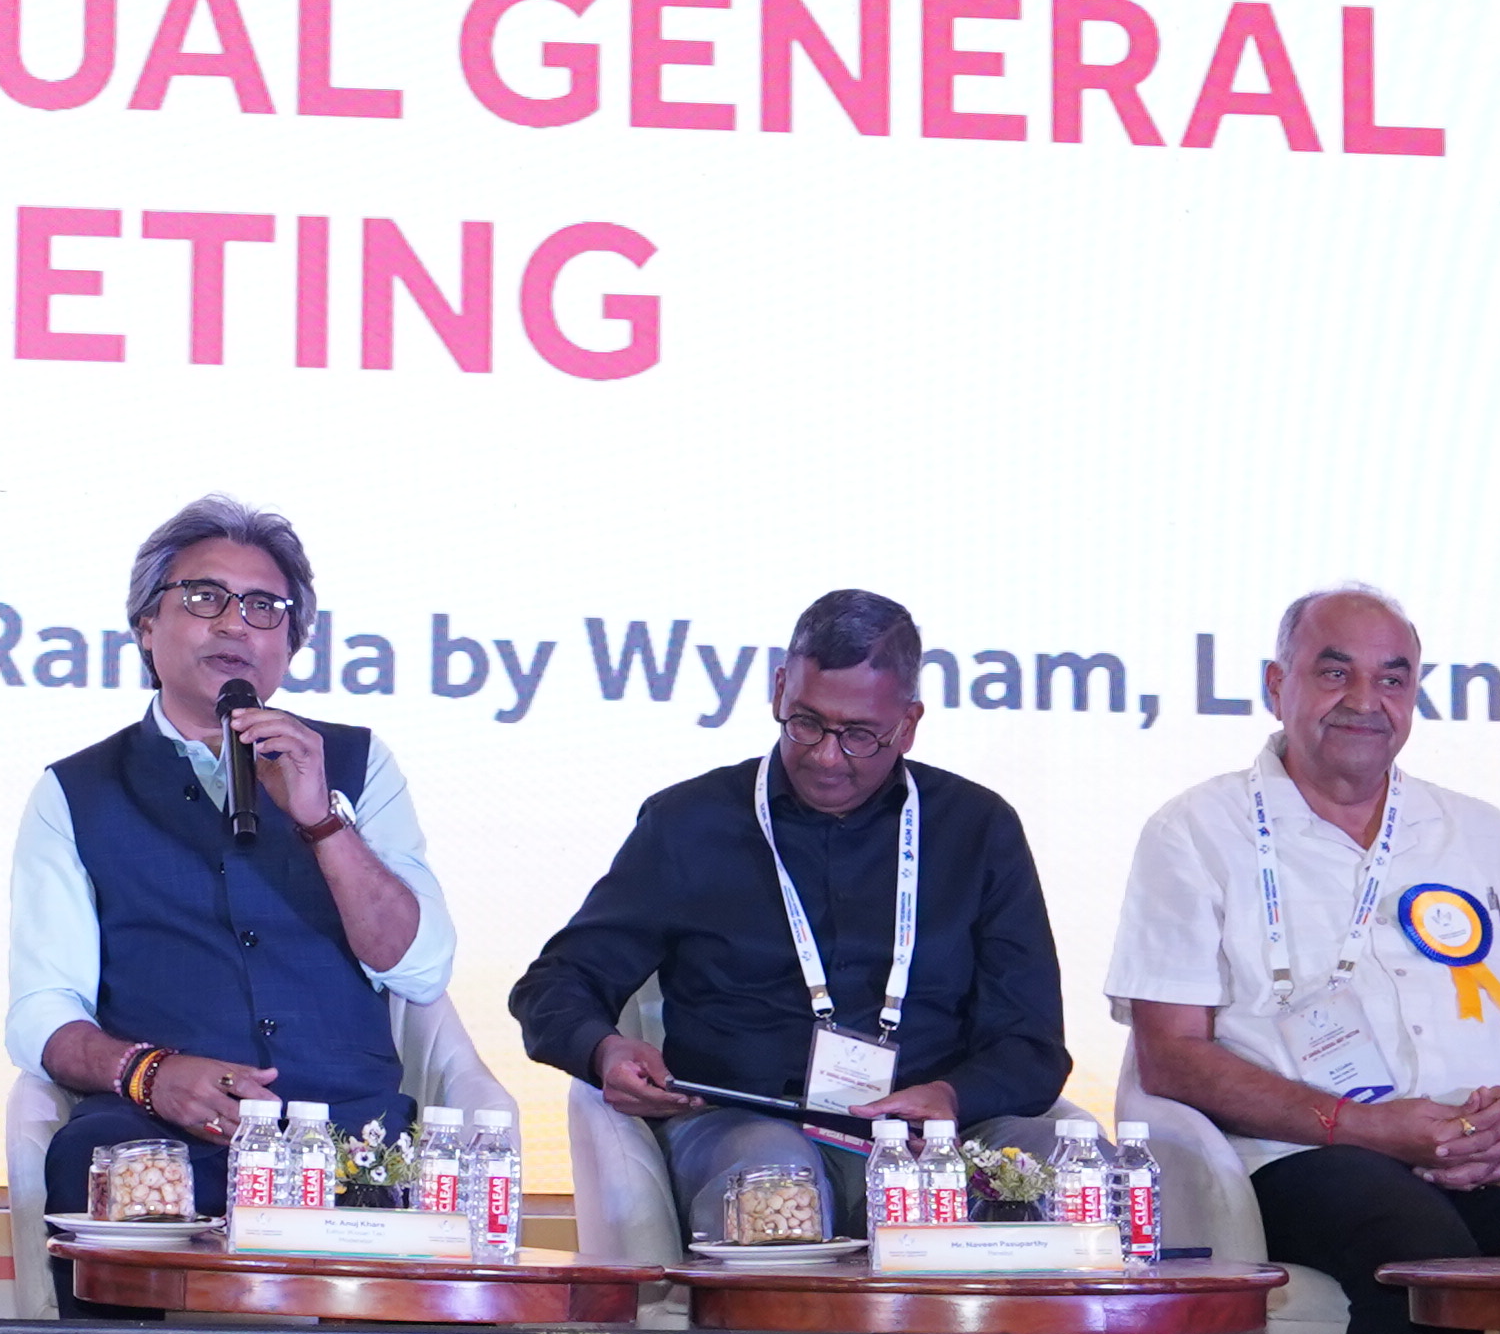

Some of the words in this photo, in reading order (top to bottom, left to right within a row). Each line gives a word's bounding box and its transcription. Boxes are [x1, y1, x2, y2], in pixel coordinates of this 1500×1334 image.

[430, 612, 557, 725] by
[584, 616, 1161, 731] Wyham,
[905, 808, 913, 827] 2025
[905, 828, 913, 847] AGM
[253, 1168, 269, 1205] CLEAR
[304, 1168, 319, 1205] CLEAR
[437, 1174, 451, 1212] CLEAR
[491, 1177, 504, 1214] CLEAR
[1134, 1187, 1147, 1225] CLEAR
[339, 1220, 359, 1230] Anuj
[360, 1221, 385, 1229] Khare
[966, 1241, 999, 1249] Naveen
